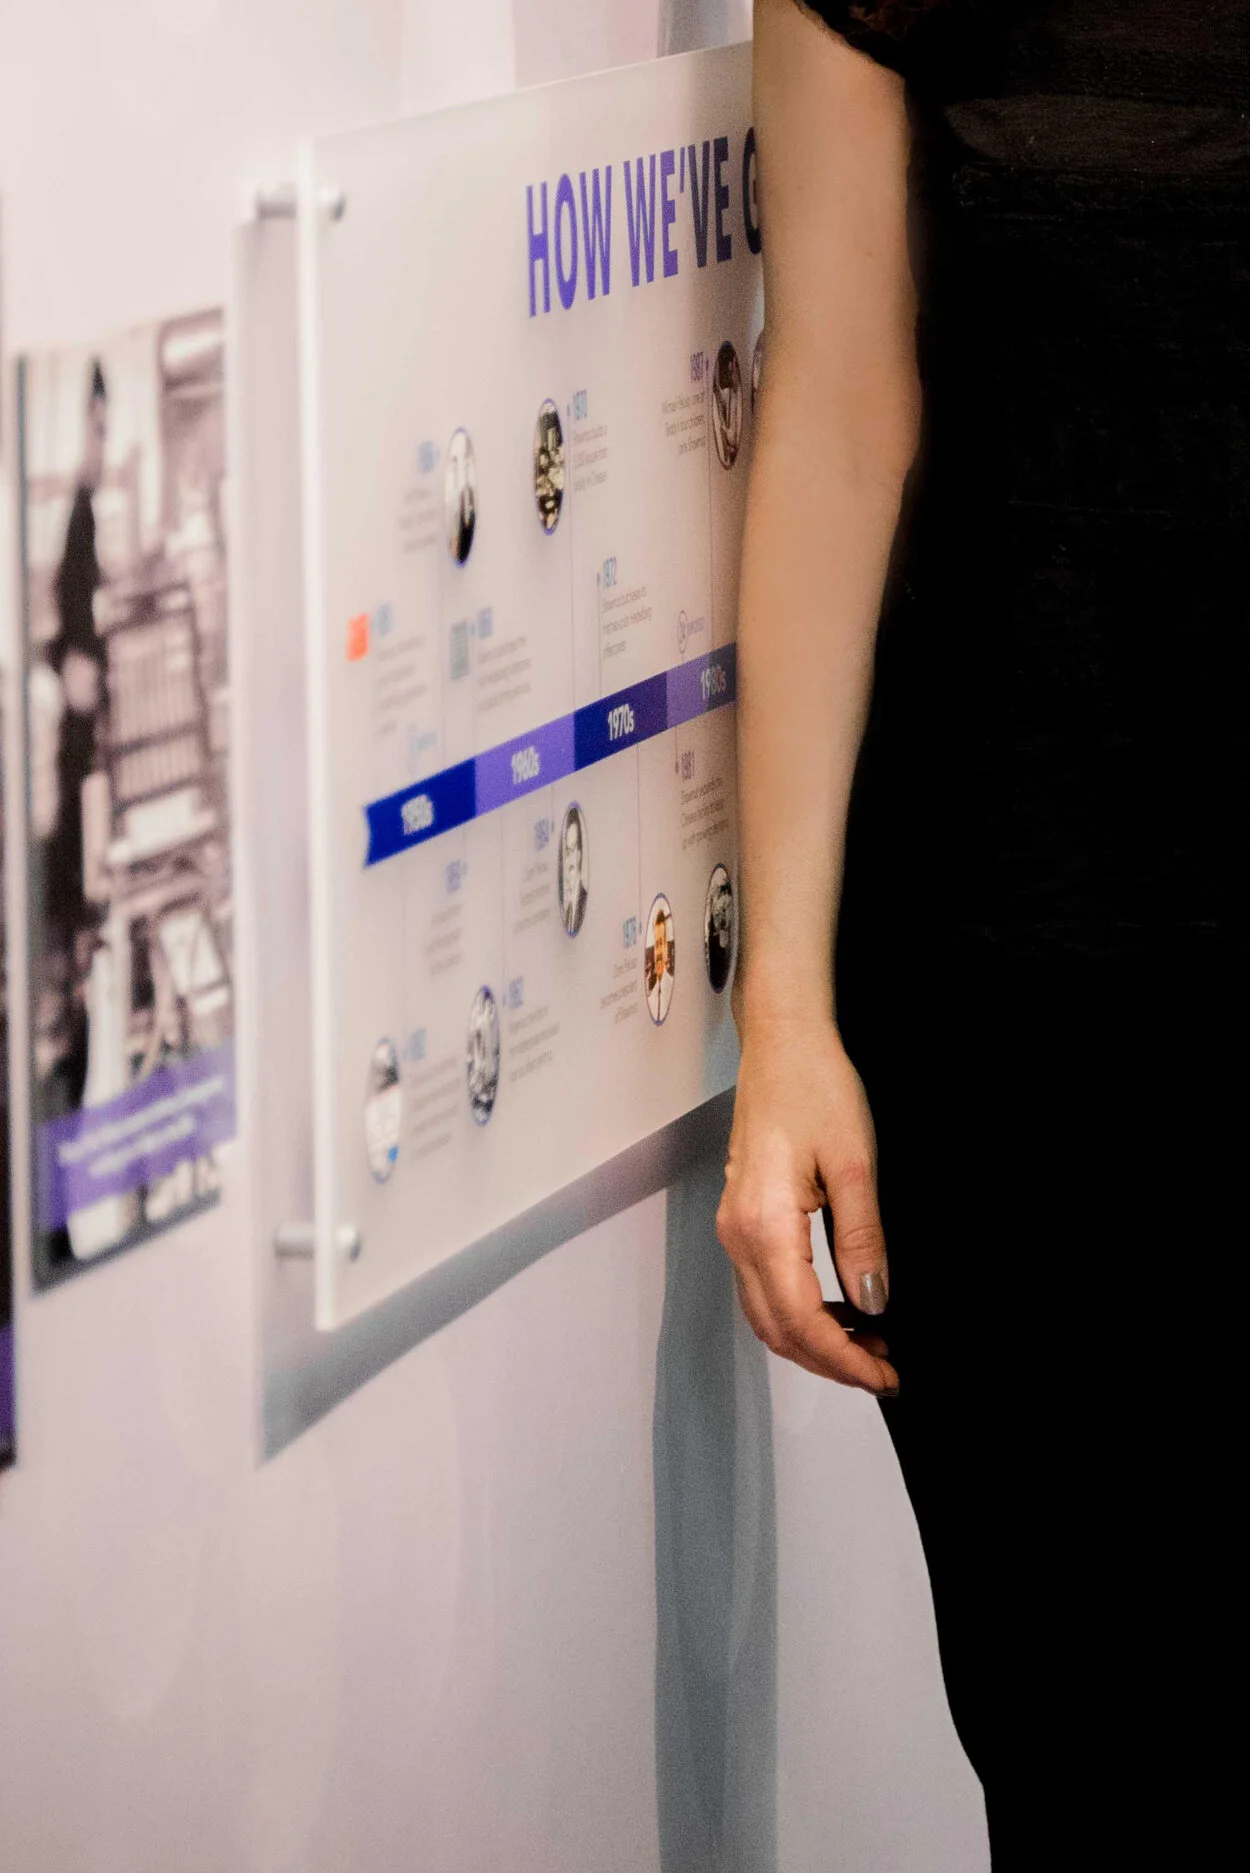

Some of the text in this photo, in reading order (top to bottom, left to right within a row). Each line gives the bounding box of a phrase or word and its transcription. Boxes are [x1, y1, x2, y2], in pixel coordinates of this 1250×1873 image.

[526, 164, 612, 318] HOW
[624, 136, 732, 287] WE'VE
[701, 663, 727, 701] 1980s
[607, 703, 635, 742] 1970s
[511, 745, 541, 785] 1960s
